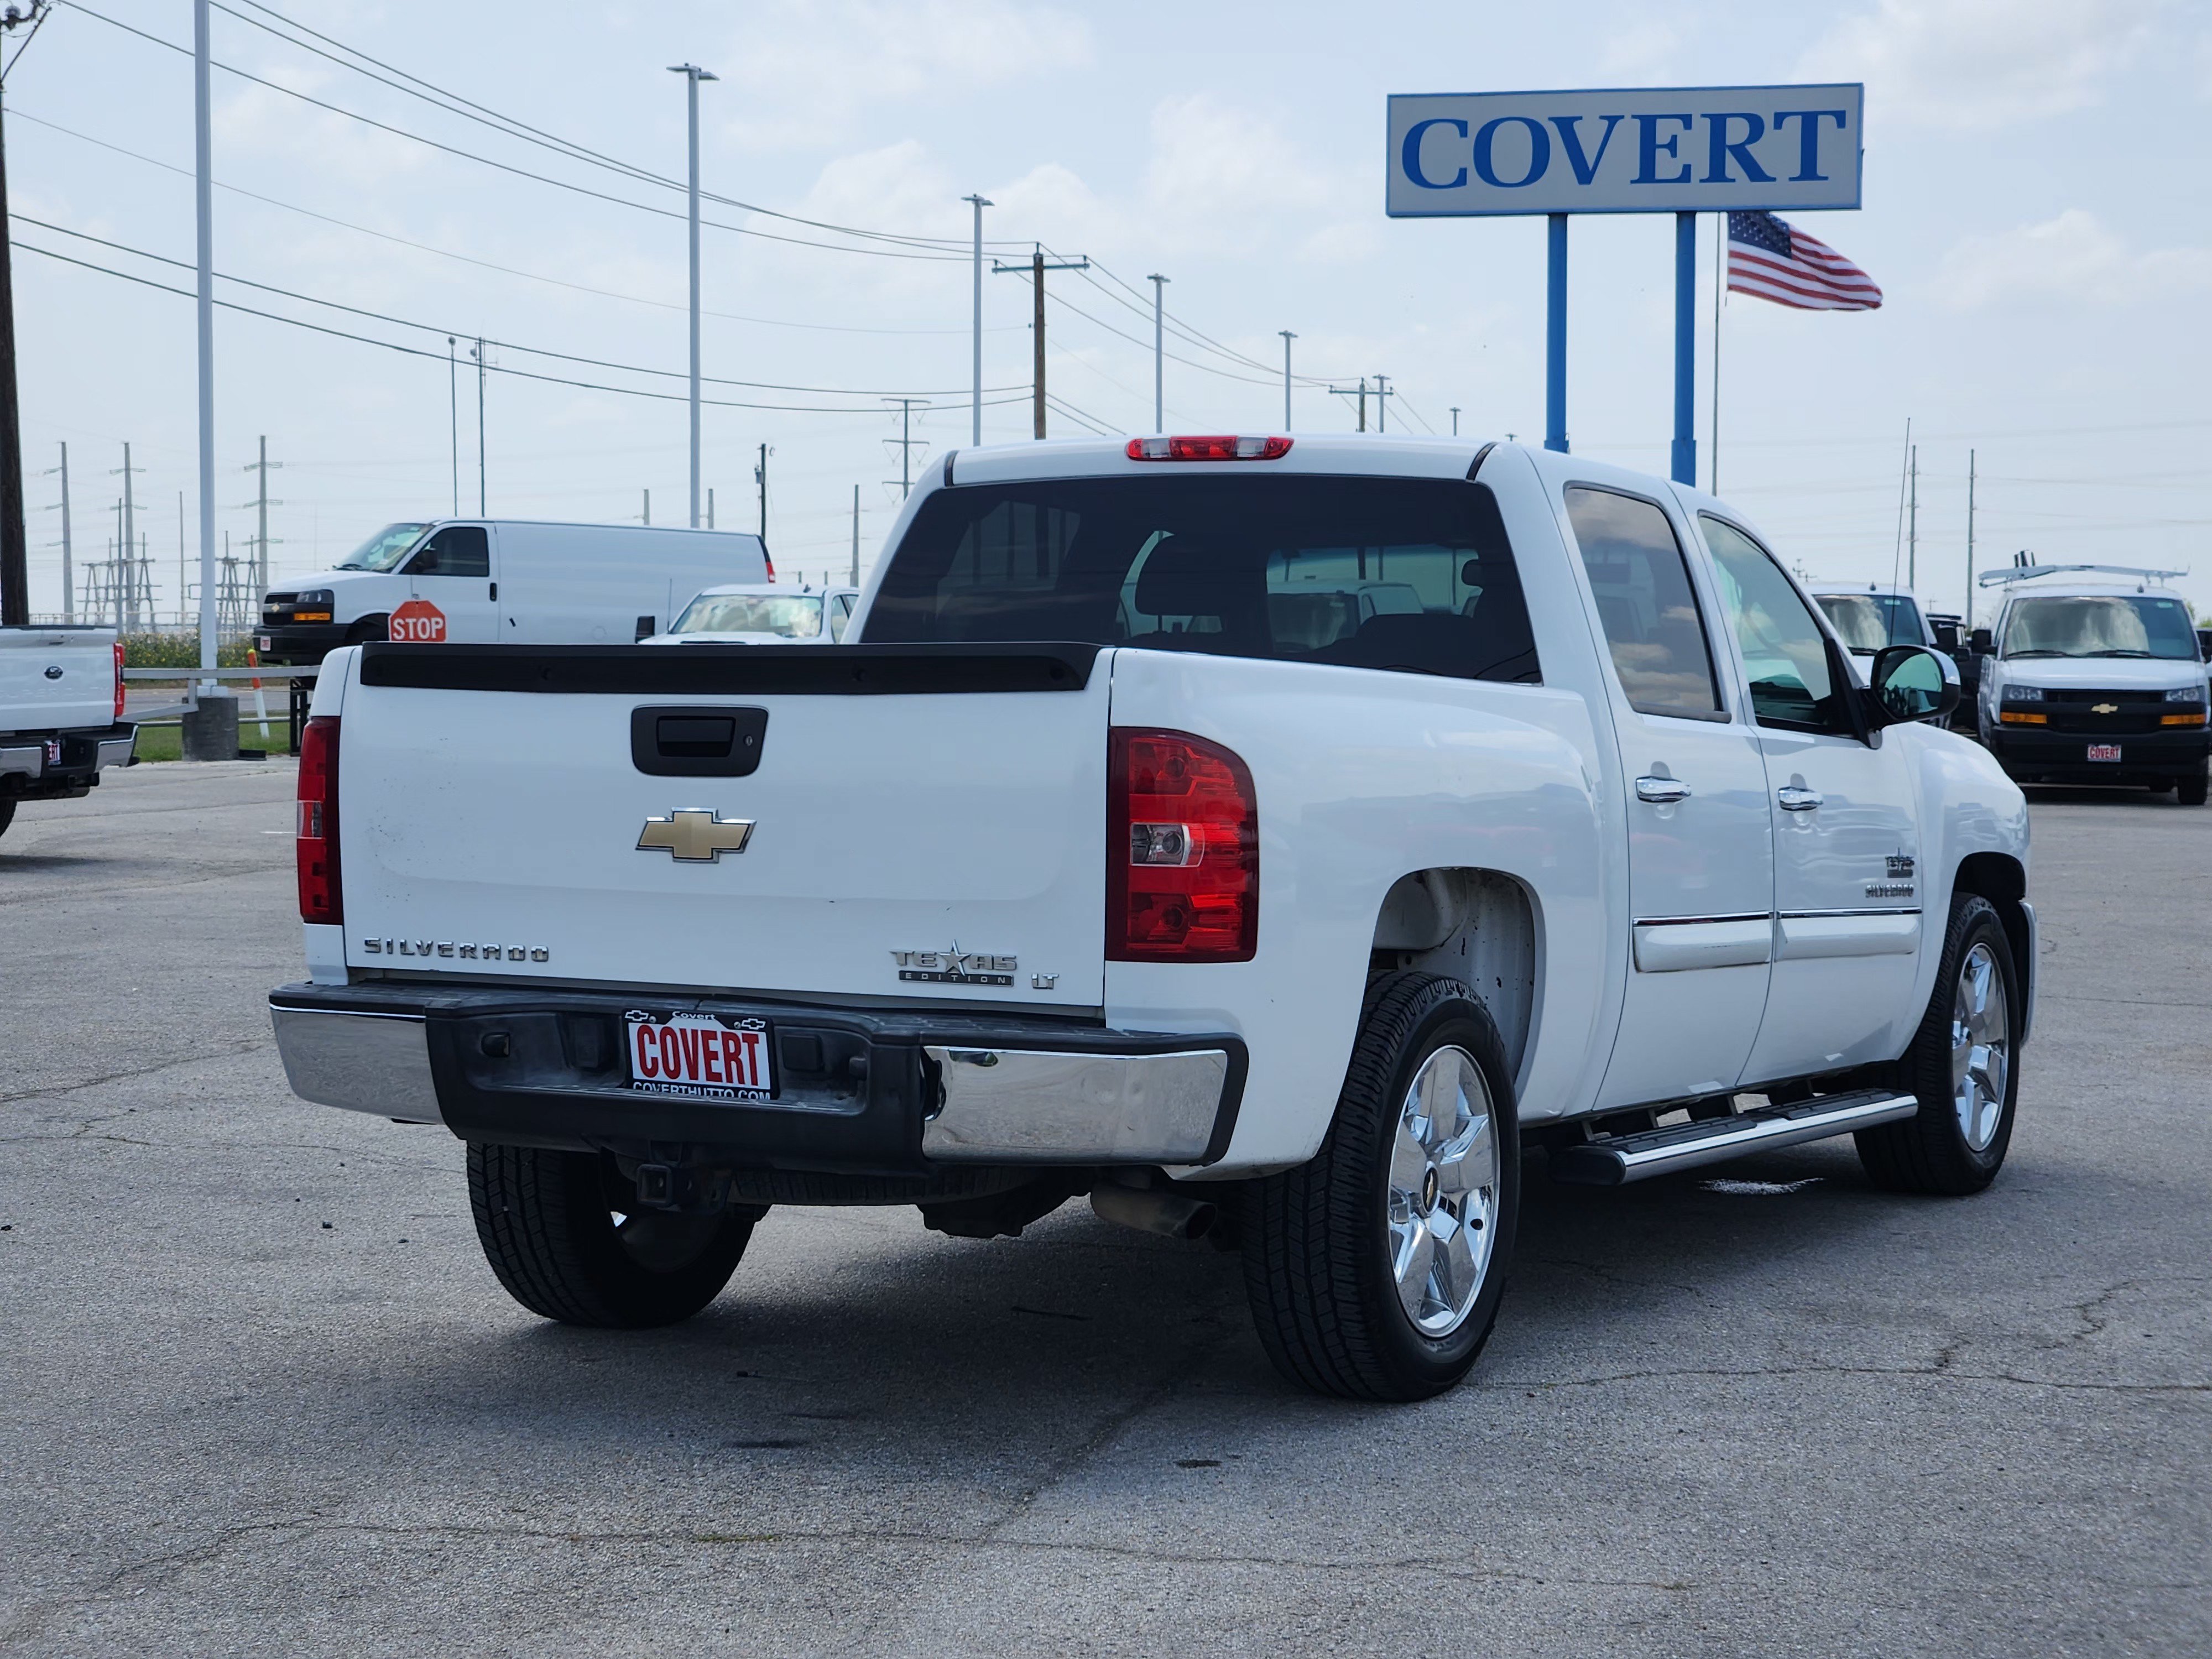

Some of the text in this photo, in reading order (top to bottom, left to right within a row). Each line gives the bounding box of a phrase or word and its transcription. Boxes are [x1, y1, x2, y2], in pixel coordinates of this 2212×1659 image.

[1401, 110, 1846, 189] COVERT
[393, 617, 444, 640] STOP
[2089, 747, 2119, 759] COVERT
[364, 936, 549, 962] SILVERADO
[905, 972, 1006, 984] EDITION
[1031, 973, 1060, 990] LT
[671, 1011, 717, 1020] Covert
[637, 1024, 760, 1086] COVERT
